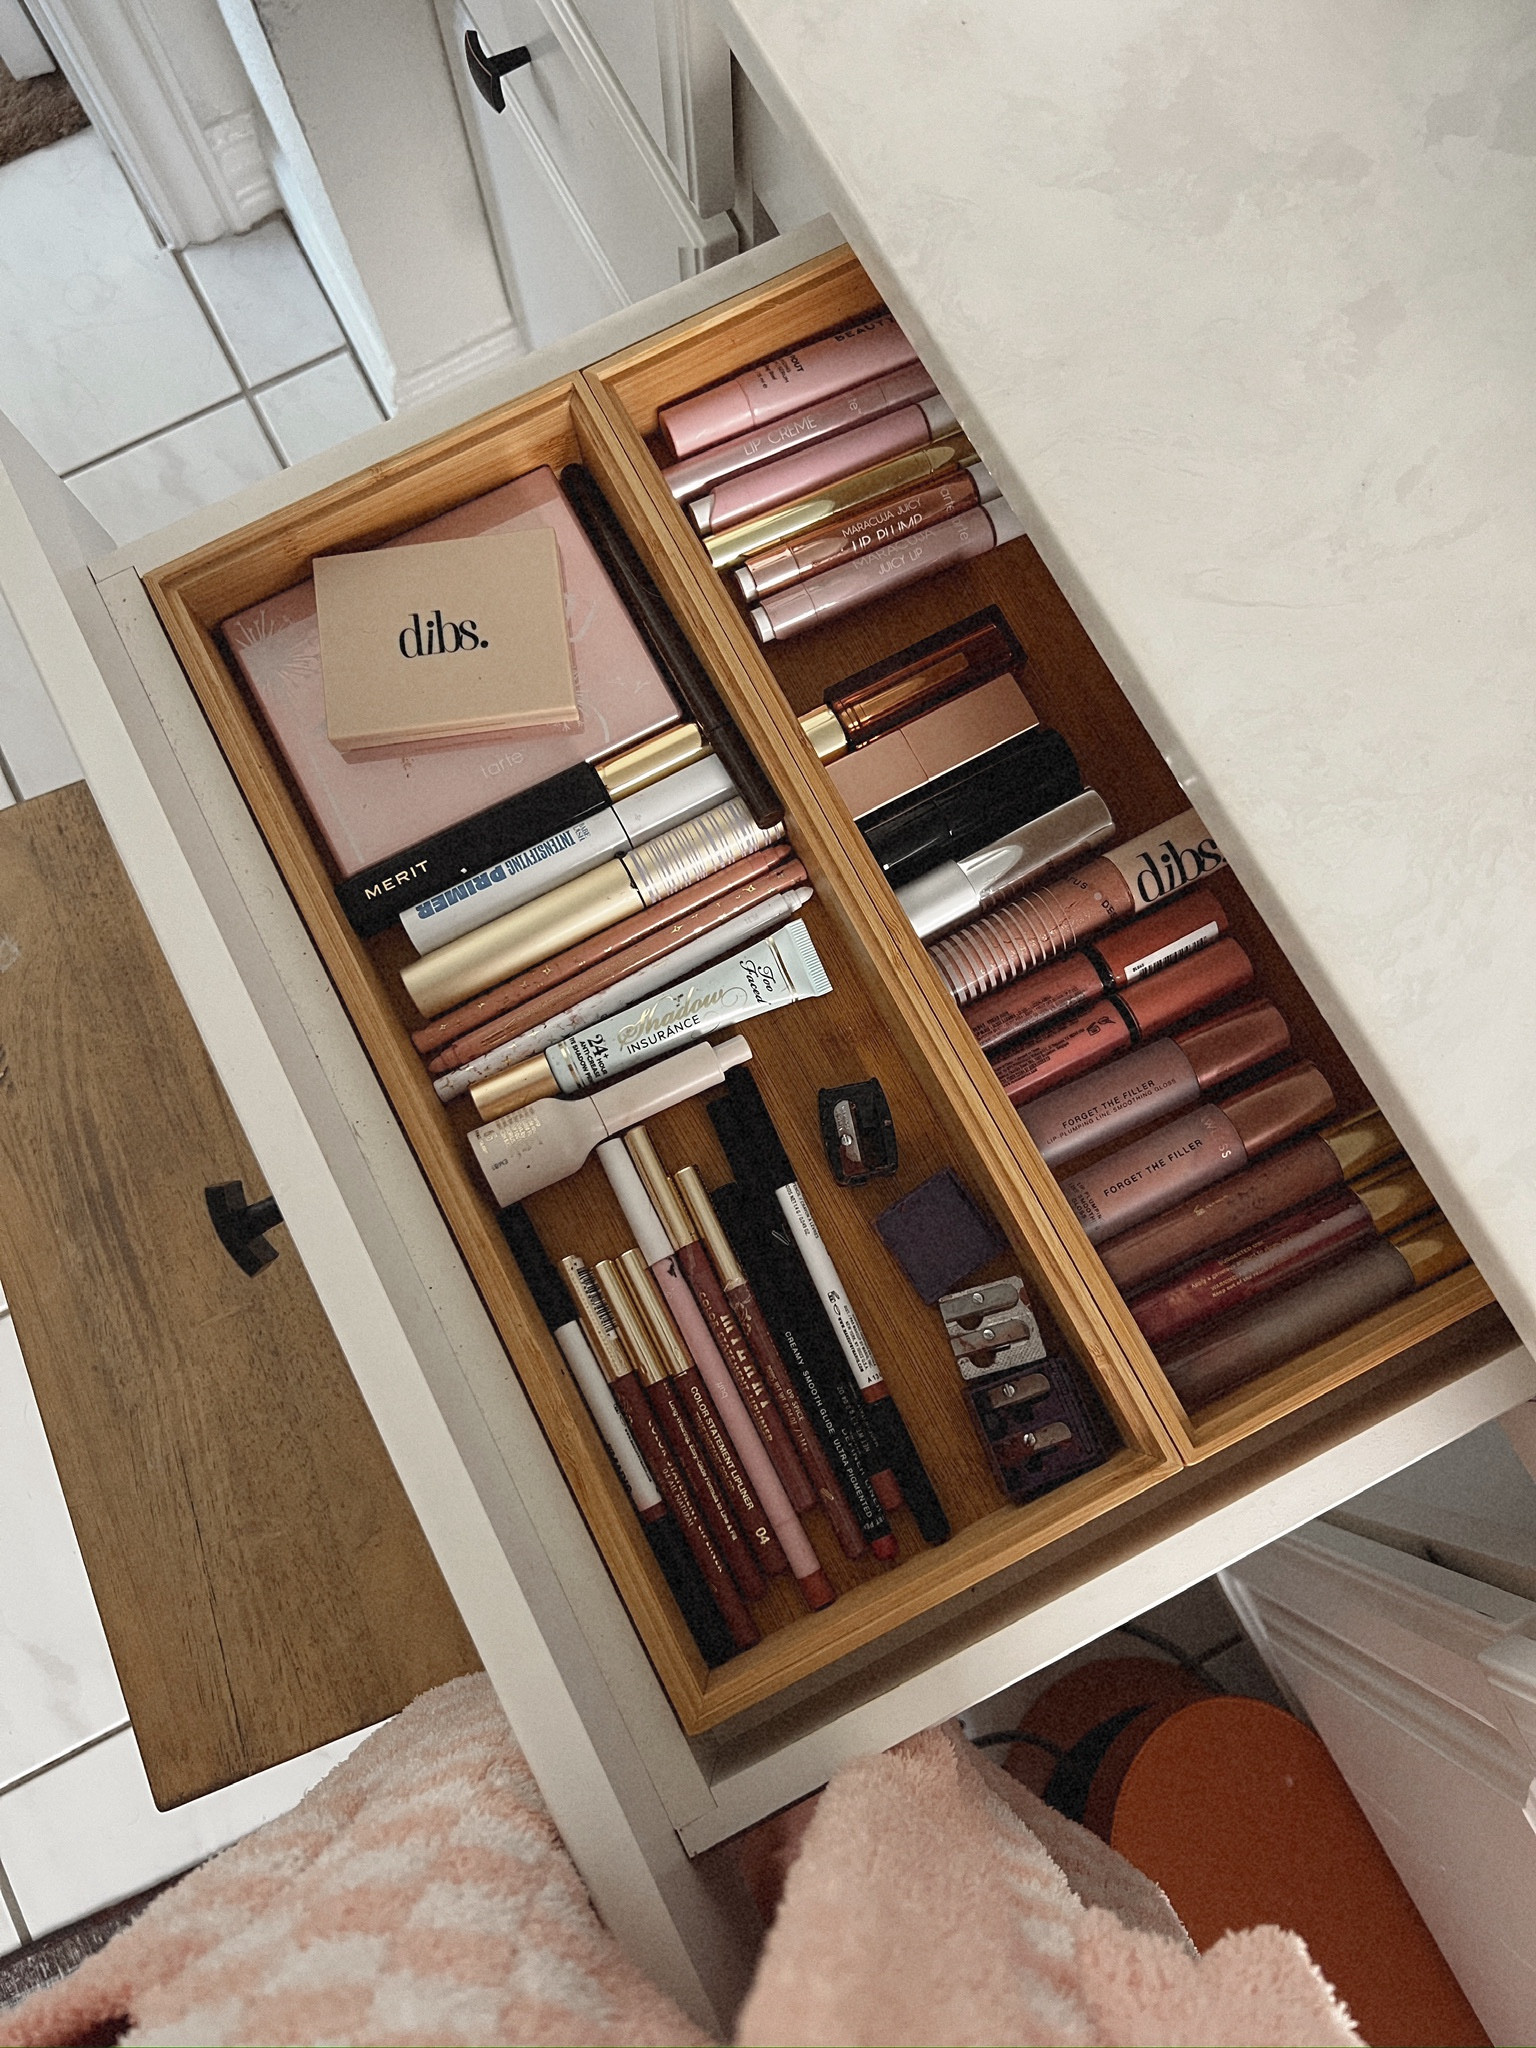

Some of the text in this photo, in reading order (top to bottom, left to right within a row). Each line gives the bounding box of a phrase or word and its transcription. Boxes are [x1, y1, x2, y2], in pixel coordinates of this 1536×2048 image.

[742, 414, 817, 456] LIP CREME
[841, 498, 922, 538] MARACUJA JUICY
[876, 547, 924, 575] JUICY LIP
[399, 610, 488, 659] dibs.
[480, 749, 525, 779] tarte
[364, 860, 428, 900] MERIT
[416, 830, 576, 920] INTENSIFYING PRIMER
[739, 958, 766, 1004] Faced
[758, 964, 778, 992] Too
[617, 986, 726, 1049] Shadow
[572, 1044, 588, 1071] SHADOW
[579, 1040, 600, 1077] ANTI-CREASE
[596, 1058, 607, 1074] HOUR
[1061, 1078, 1155, 1129] FORGET THE FILLER
[1153, 1078, 1176, 1092] GLOSS
[1102, 1138, 1202, 1197] FORGET THE FILLER
[1071, 1197, 1086, 1219] GLOSS
[1190, 1277, 1207, 1289] Apply
[697, 1290, 720, 1328] COLOR
[716, 1330, 749, 1392] STATEMENT
[783, 1330, 805, 1366] CREAMY
[801, 1369, 823, 1407] SMOOTH
[818, 1408, 836, 1435] GLIDE
[831, 1438, 849, 1467] ULTRA
[845, 1467, 873, 1519] PIGMENTED
[790, 1400, 805, 1422] SPICE
[689, 1385, 754, 1510] COLOR STATEMENT LIPLINER
[666, 1479, 677, 1492] ALL
[673, 1493, 694, 1527] NATURAL
[756, 1526, 770, 1545] 04
